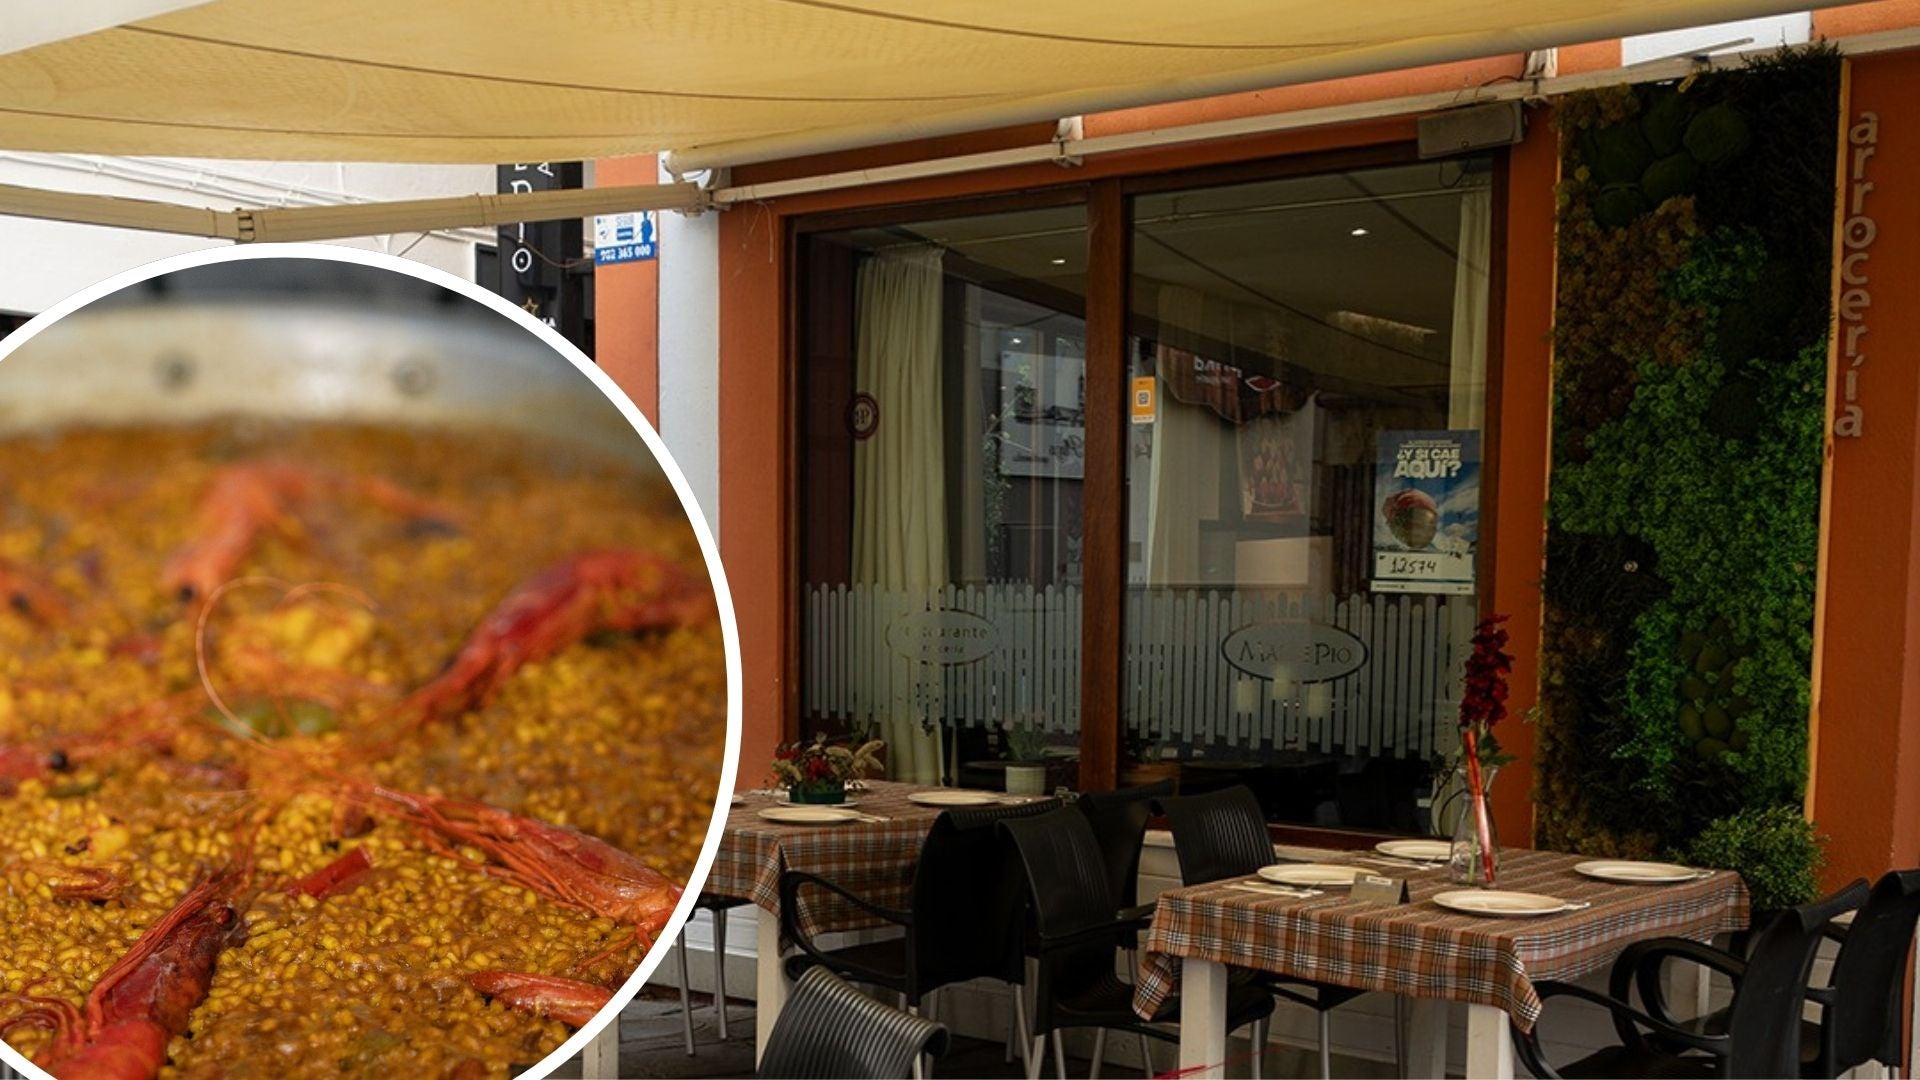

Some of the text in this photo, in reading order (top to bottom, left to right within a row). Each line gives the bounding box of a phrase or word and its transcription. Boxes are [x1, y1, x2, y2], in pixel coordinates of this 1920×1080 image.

[1834, 111, 1878, 437] arrocería
[1415, 449, 1428, 460] SI
[1430, 449, 1461, 460] CAE
